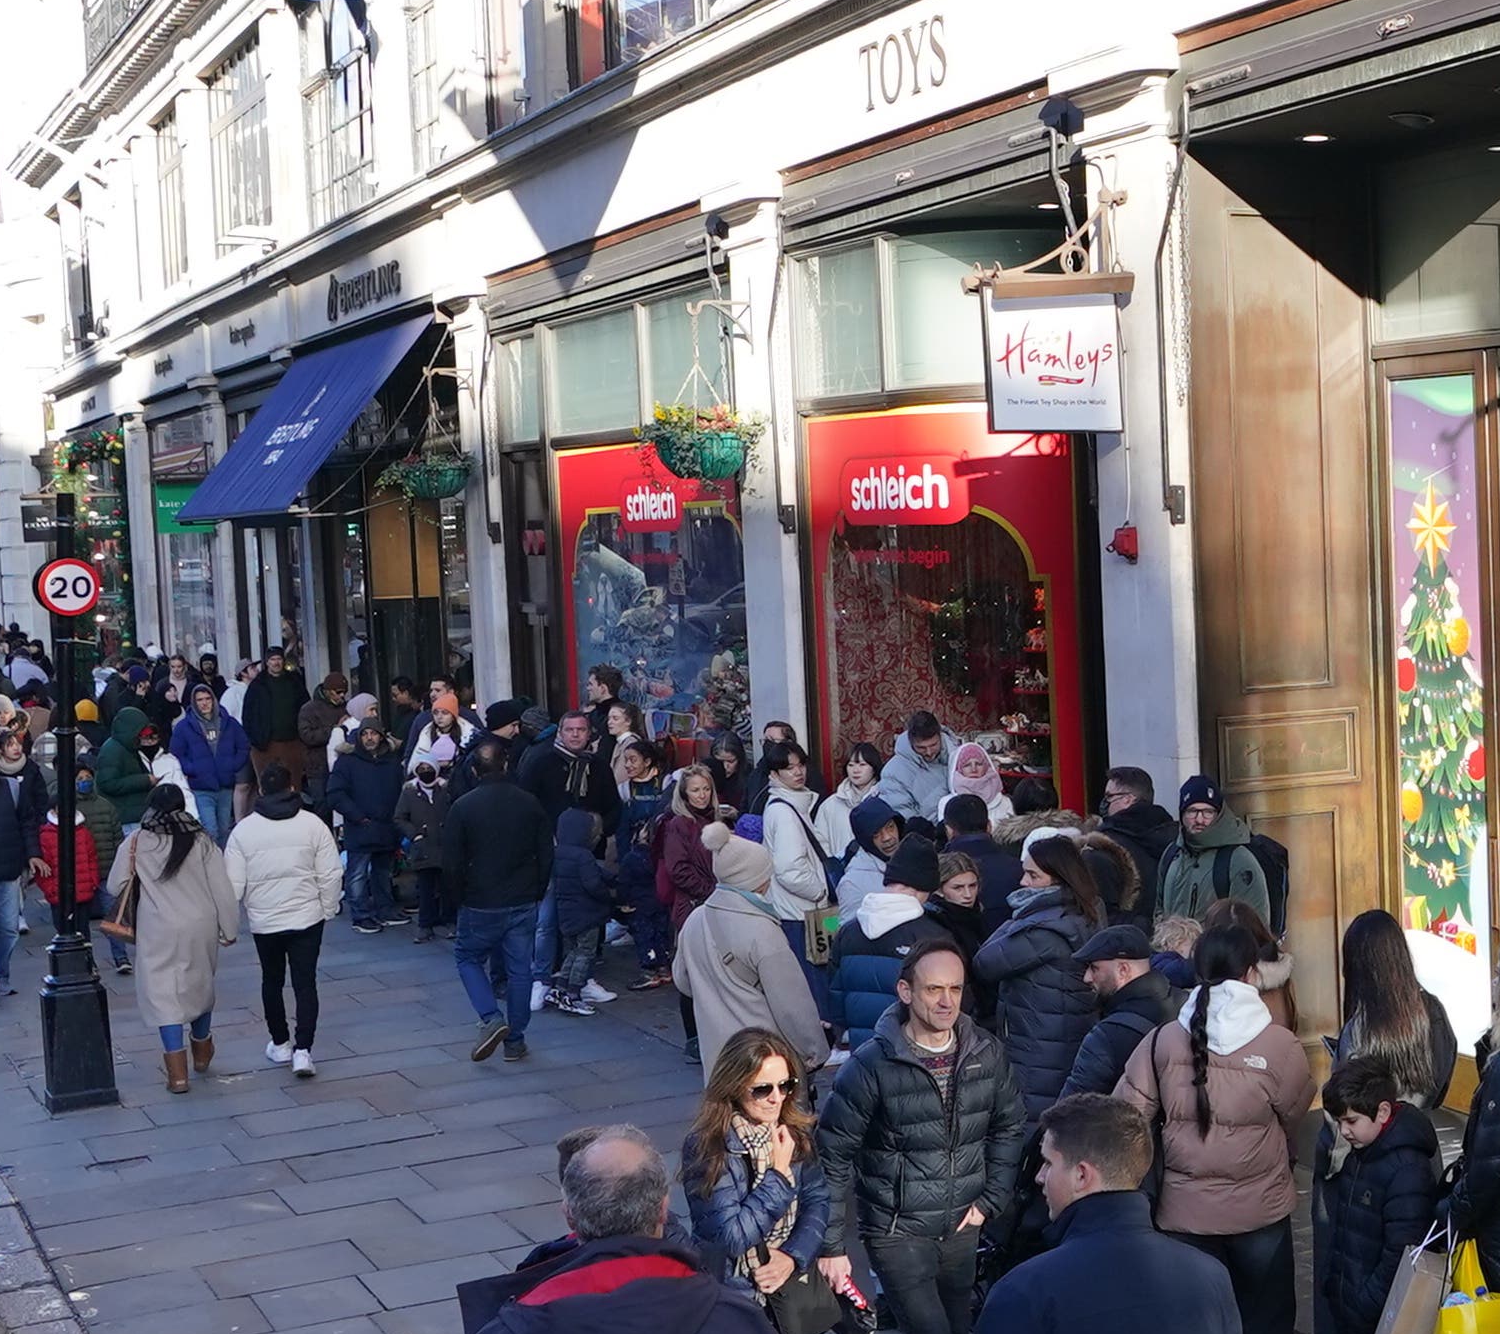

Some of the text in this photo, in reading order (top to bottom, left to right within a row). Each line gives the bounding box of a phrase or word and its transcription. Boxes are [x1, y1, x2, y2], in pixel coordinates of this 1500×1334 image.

[859, 14, 949, 113] TOYS
[339, 260, 401, 315] BREITLING
[996, 320, 1113, 387] Hamleys
[627, 486, 676, 521] schleich
[851, 464, 950, 511] schleich
[908, 545, 950, 569] begin
[50, 576, 92, 598] 20
